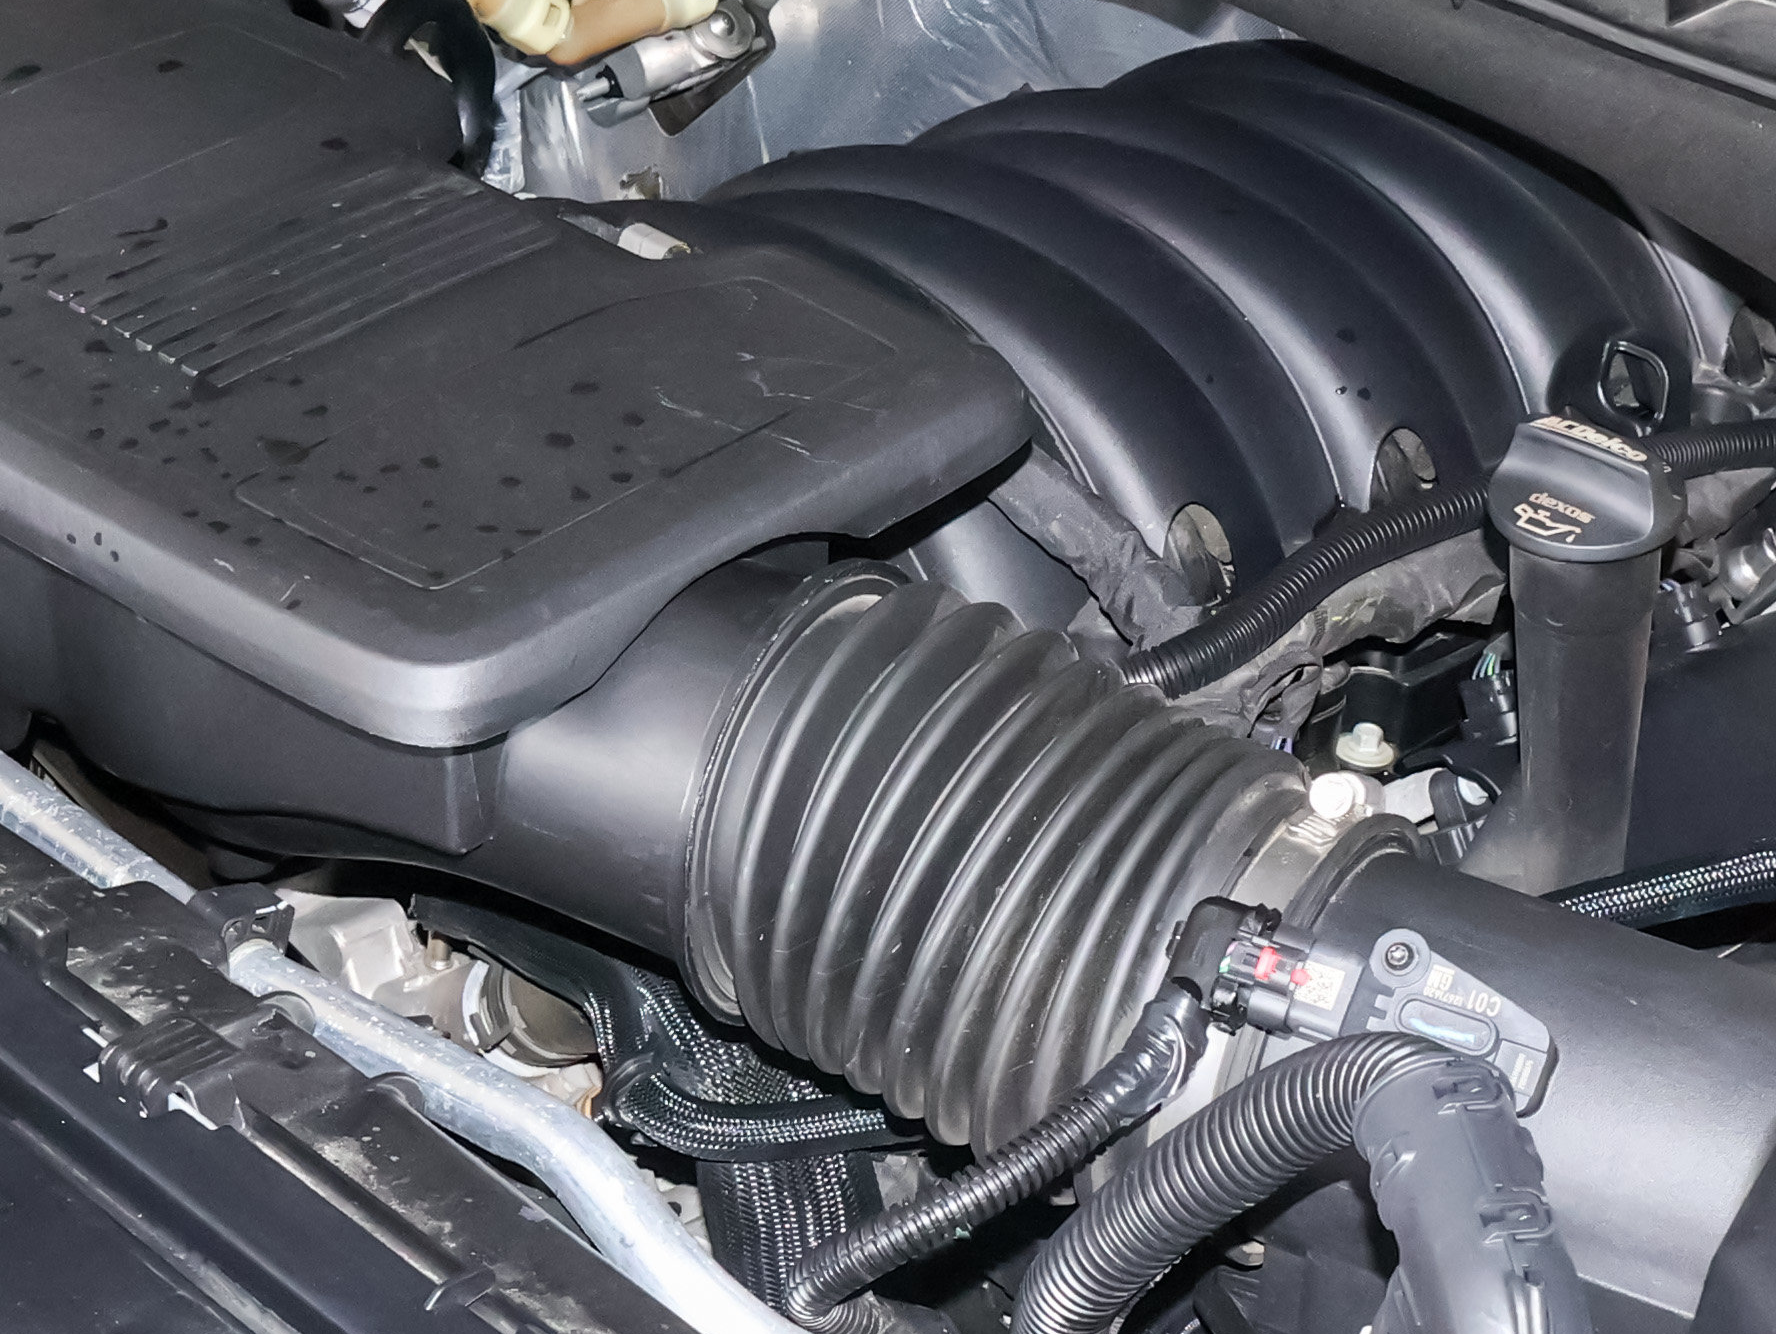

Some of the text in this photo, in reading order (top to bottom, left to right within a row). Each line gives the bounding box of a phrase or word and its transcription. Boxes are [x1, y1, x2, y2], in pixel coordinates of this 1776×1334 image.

[1528, 415, 1648, 462] ACDelco
[1529, 493, 1596, 523] dexos
[1466, 989, 1502, 1017] C01
